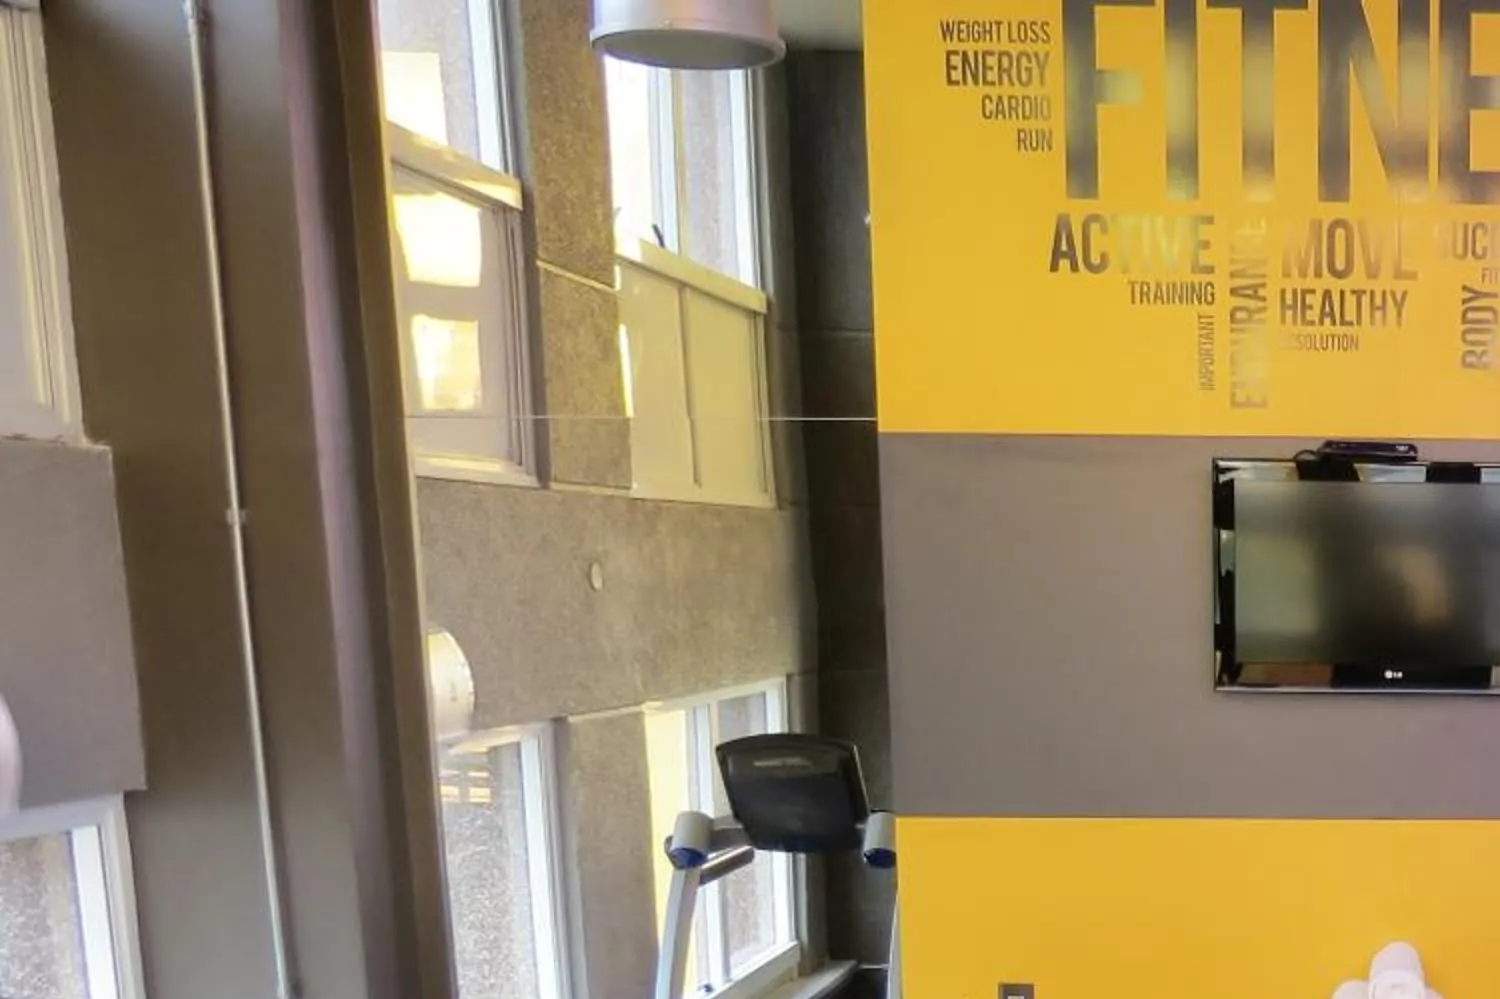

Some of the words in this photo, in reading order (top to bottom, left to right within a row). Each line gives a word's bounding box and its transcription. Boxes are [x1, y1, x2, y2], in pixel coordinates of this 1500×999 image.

[940, 19, 1003, 43] WEIGHT
[1008, 20, 1051, 44] LOSS
[945, 49, 1051, 88] ENERGY
[982, 94, 1052, 121] CARDIO
[1017, 128, 1053, 152] RUN
[1050, 213, 1215, 274] ACTIVE
[1281, 218, 1418, 281] MOVE
[1129, 280, 1215, 306] TRAINING
[1229, 214, 1268, 409] EURANE
[1279, 288, 1408, 328] HEALTHY
[1279, 334, 1359, 351] SOLUTION
[1461, 285, 1500, 371] BODY
[1199, 312, 1216, 391] IMPORTANT
